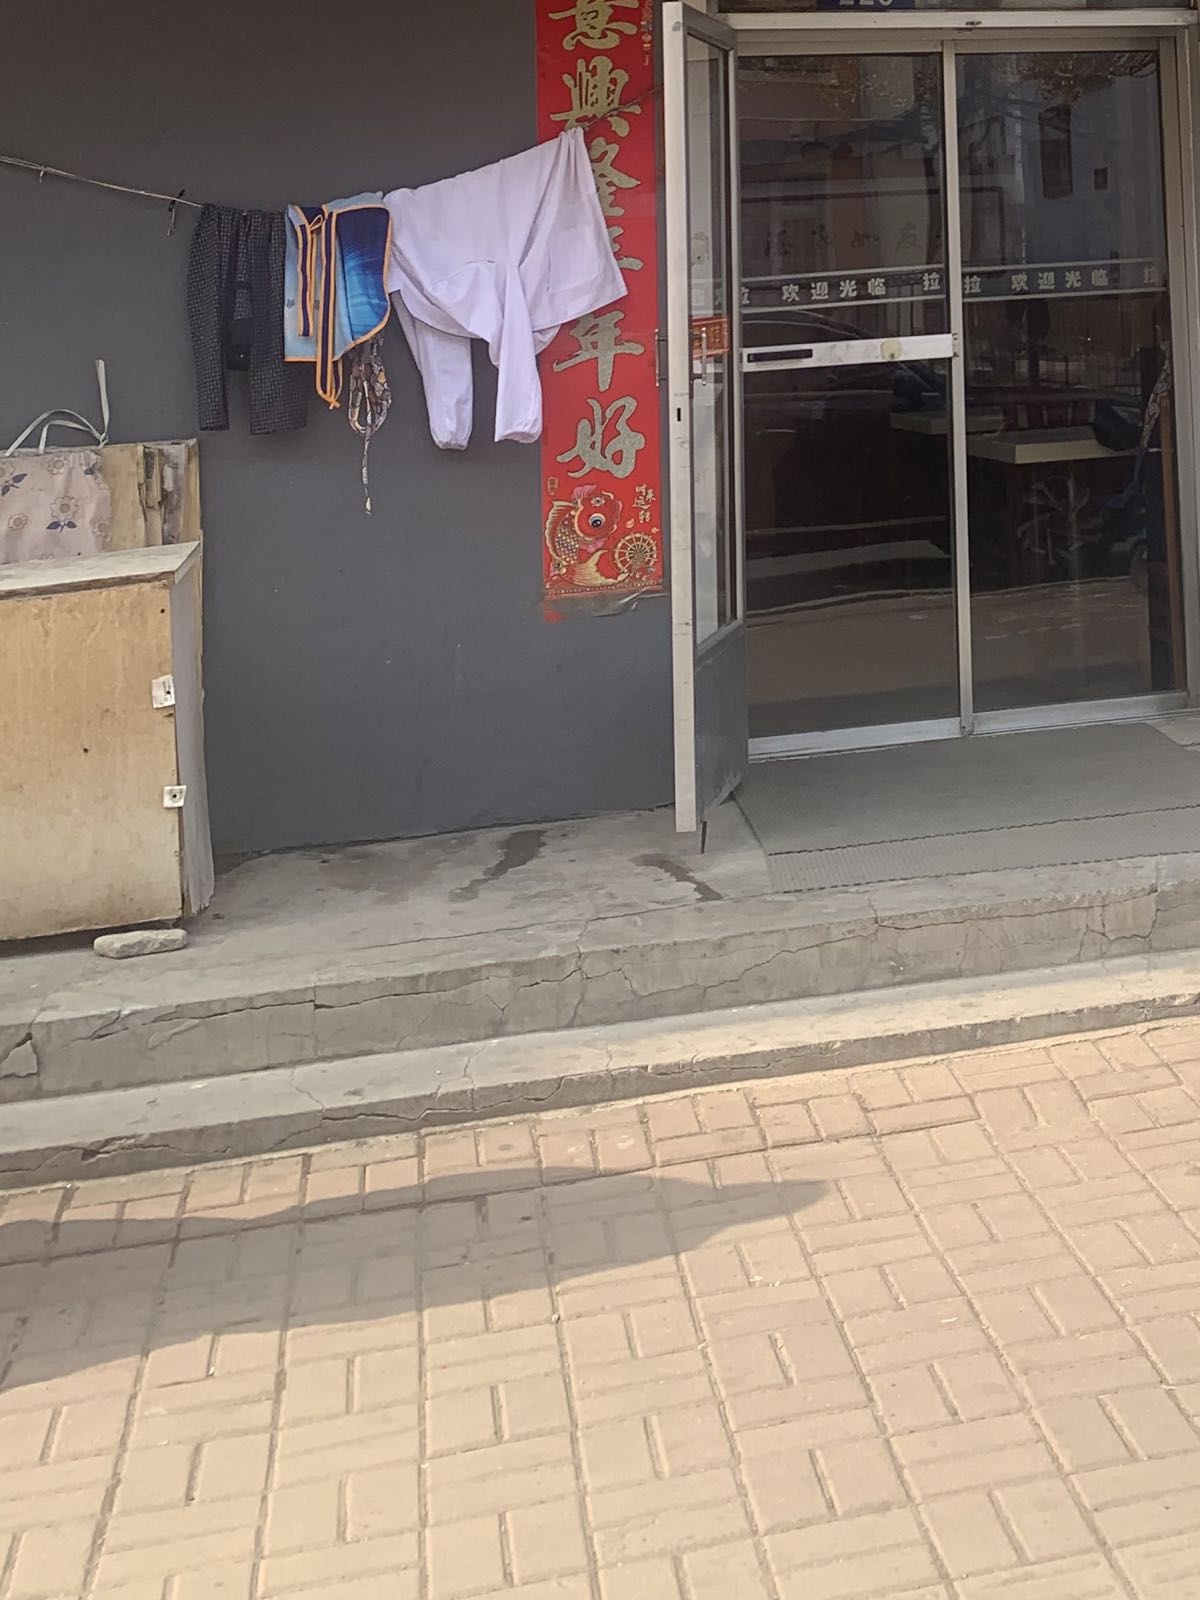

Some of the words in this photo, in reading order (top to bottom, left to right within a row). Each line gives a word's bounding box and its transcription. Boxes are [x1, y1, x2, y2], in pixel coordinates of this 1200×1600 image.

[781, 276, 887, 302] 欢迎光临
[922, 272, 941, 292] 拉
[963, 275, 981, 294] 拉
[1010, 269, 1109, 291] 欢迎光临
